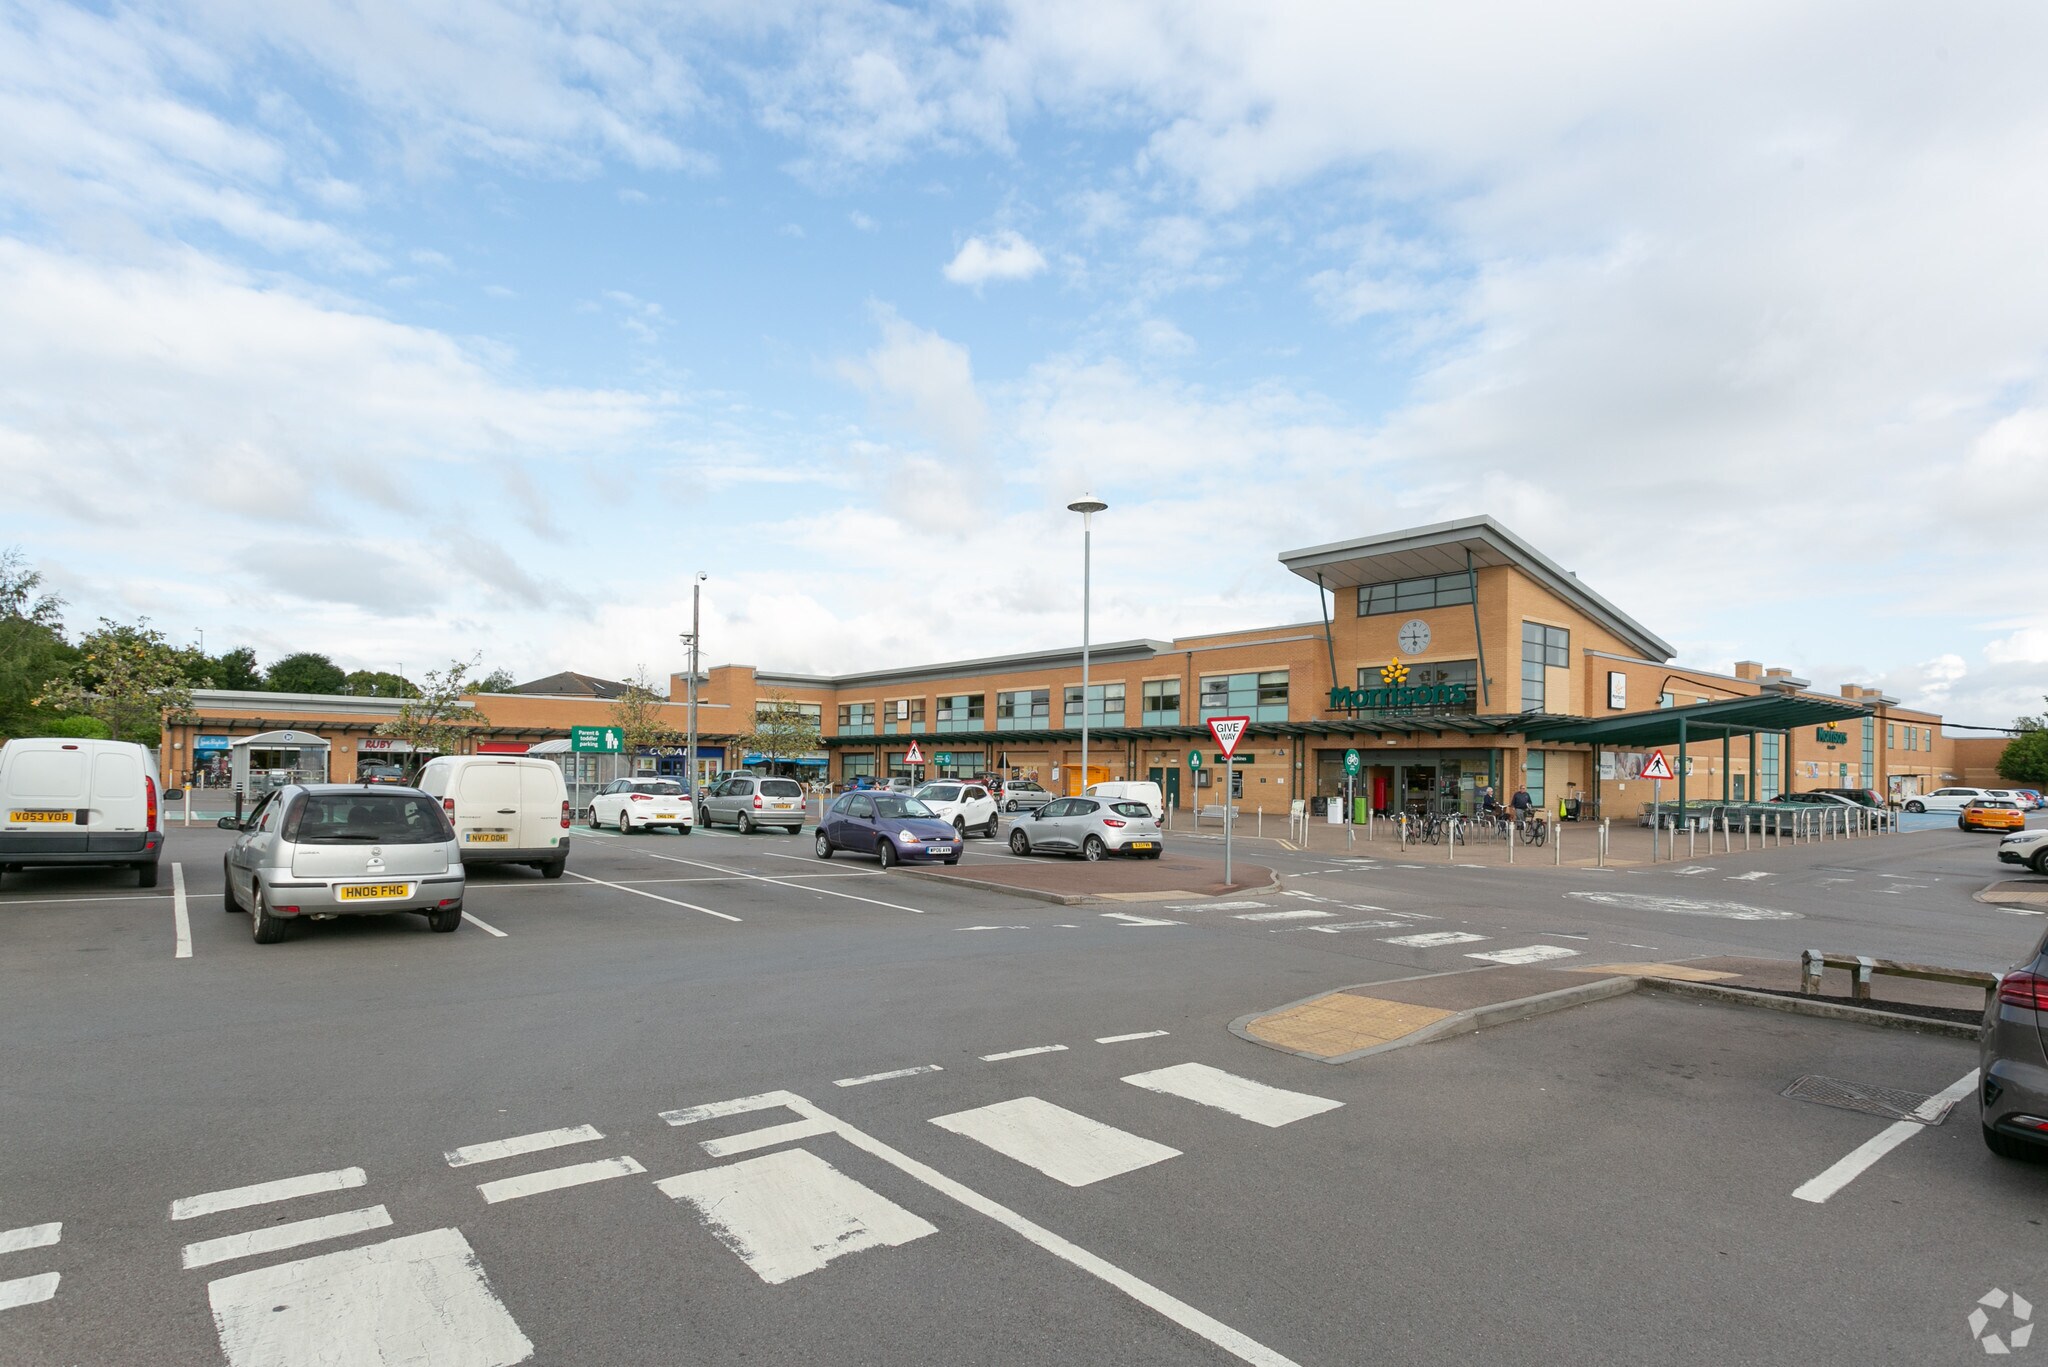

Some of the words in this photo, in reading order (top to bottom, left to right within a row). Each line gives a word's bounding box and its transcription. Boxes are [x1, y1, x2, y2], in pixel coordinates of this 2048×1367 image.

[1330, 680, 1467, 708] Morrisons
[1216, 722, 1240, 732] GIVE
[1816, 727, 1847, 744] Morrisons
[365, 740, 393, 748] RUBY
[346, 886, 377, 897] HN06
[381, 886, 404, 895] FHG
